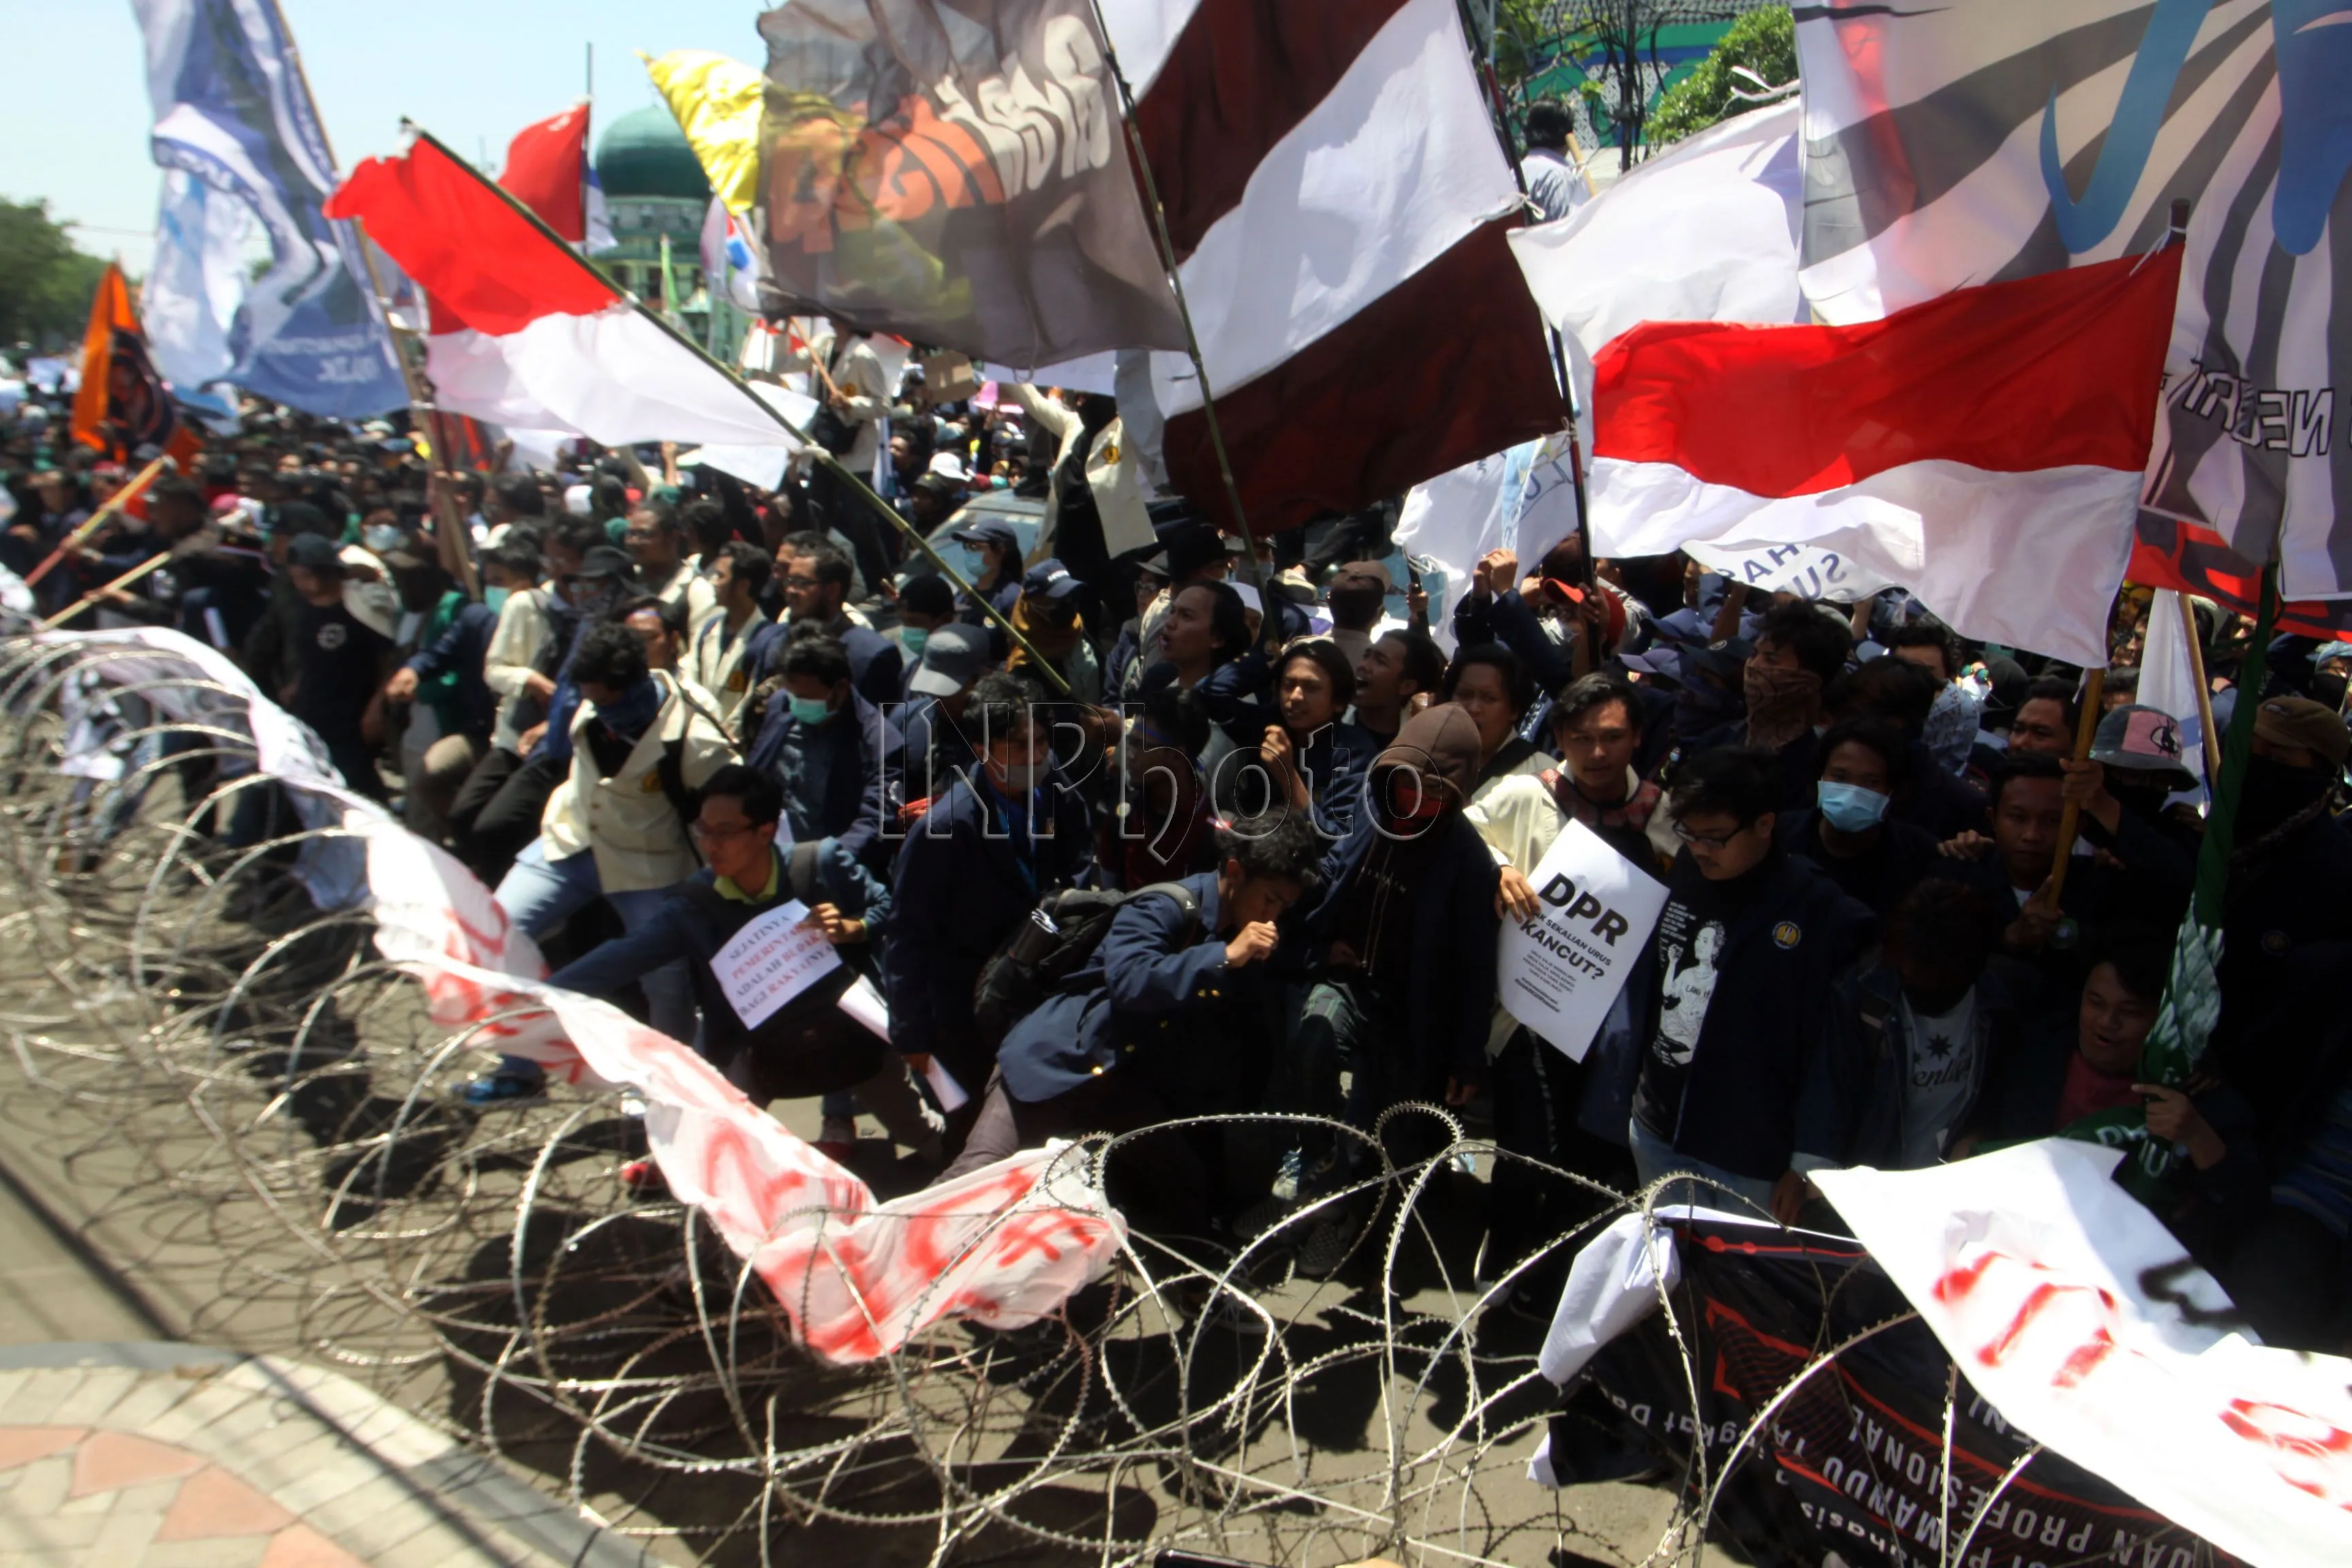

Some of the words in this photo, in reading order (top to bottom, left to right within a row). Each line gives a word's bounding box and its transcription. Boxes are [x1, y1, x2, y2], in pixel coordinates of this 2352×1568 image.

[1537, 872, 1629, 947] DPR
[1519, 919, 1605, 981] KANCUT?
[1546, 918, 1588, 951] SEKALIAN
[1588, 946, 1612, 966] URUS
[736, 958, 783, 997] ADALAH
[1849, 1405, 2093, 1554] PROFESIONAL
